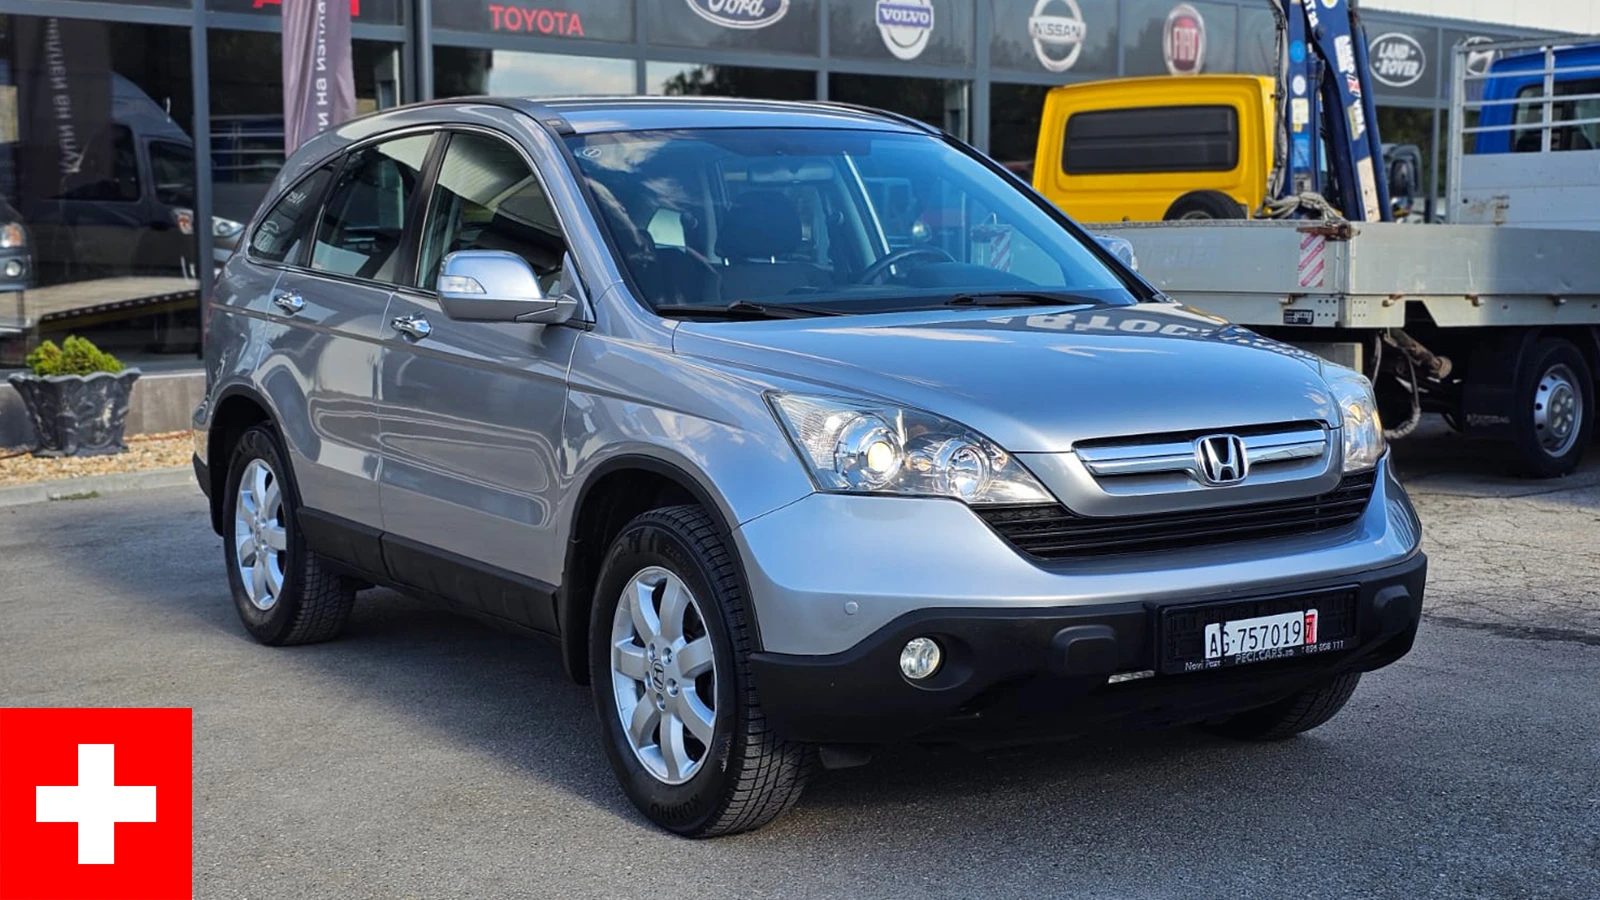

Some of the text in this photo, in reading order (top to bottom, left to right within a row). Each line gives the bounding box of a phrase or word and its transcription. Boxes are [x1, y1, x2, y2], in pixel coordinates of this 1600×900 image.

[488, 4, 584, 37] TOYOTA
[880, 8, 930, 25] VOLVO
[1034, 21, 1081, 38] NISSAN
[1173, 27, 1198, 61] FIAT
[1378, 41, 1410, 59] LAND
[1379, 59, 1420, 77] ROVER
[315, 77, 328, 106] на
